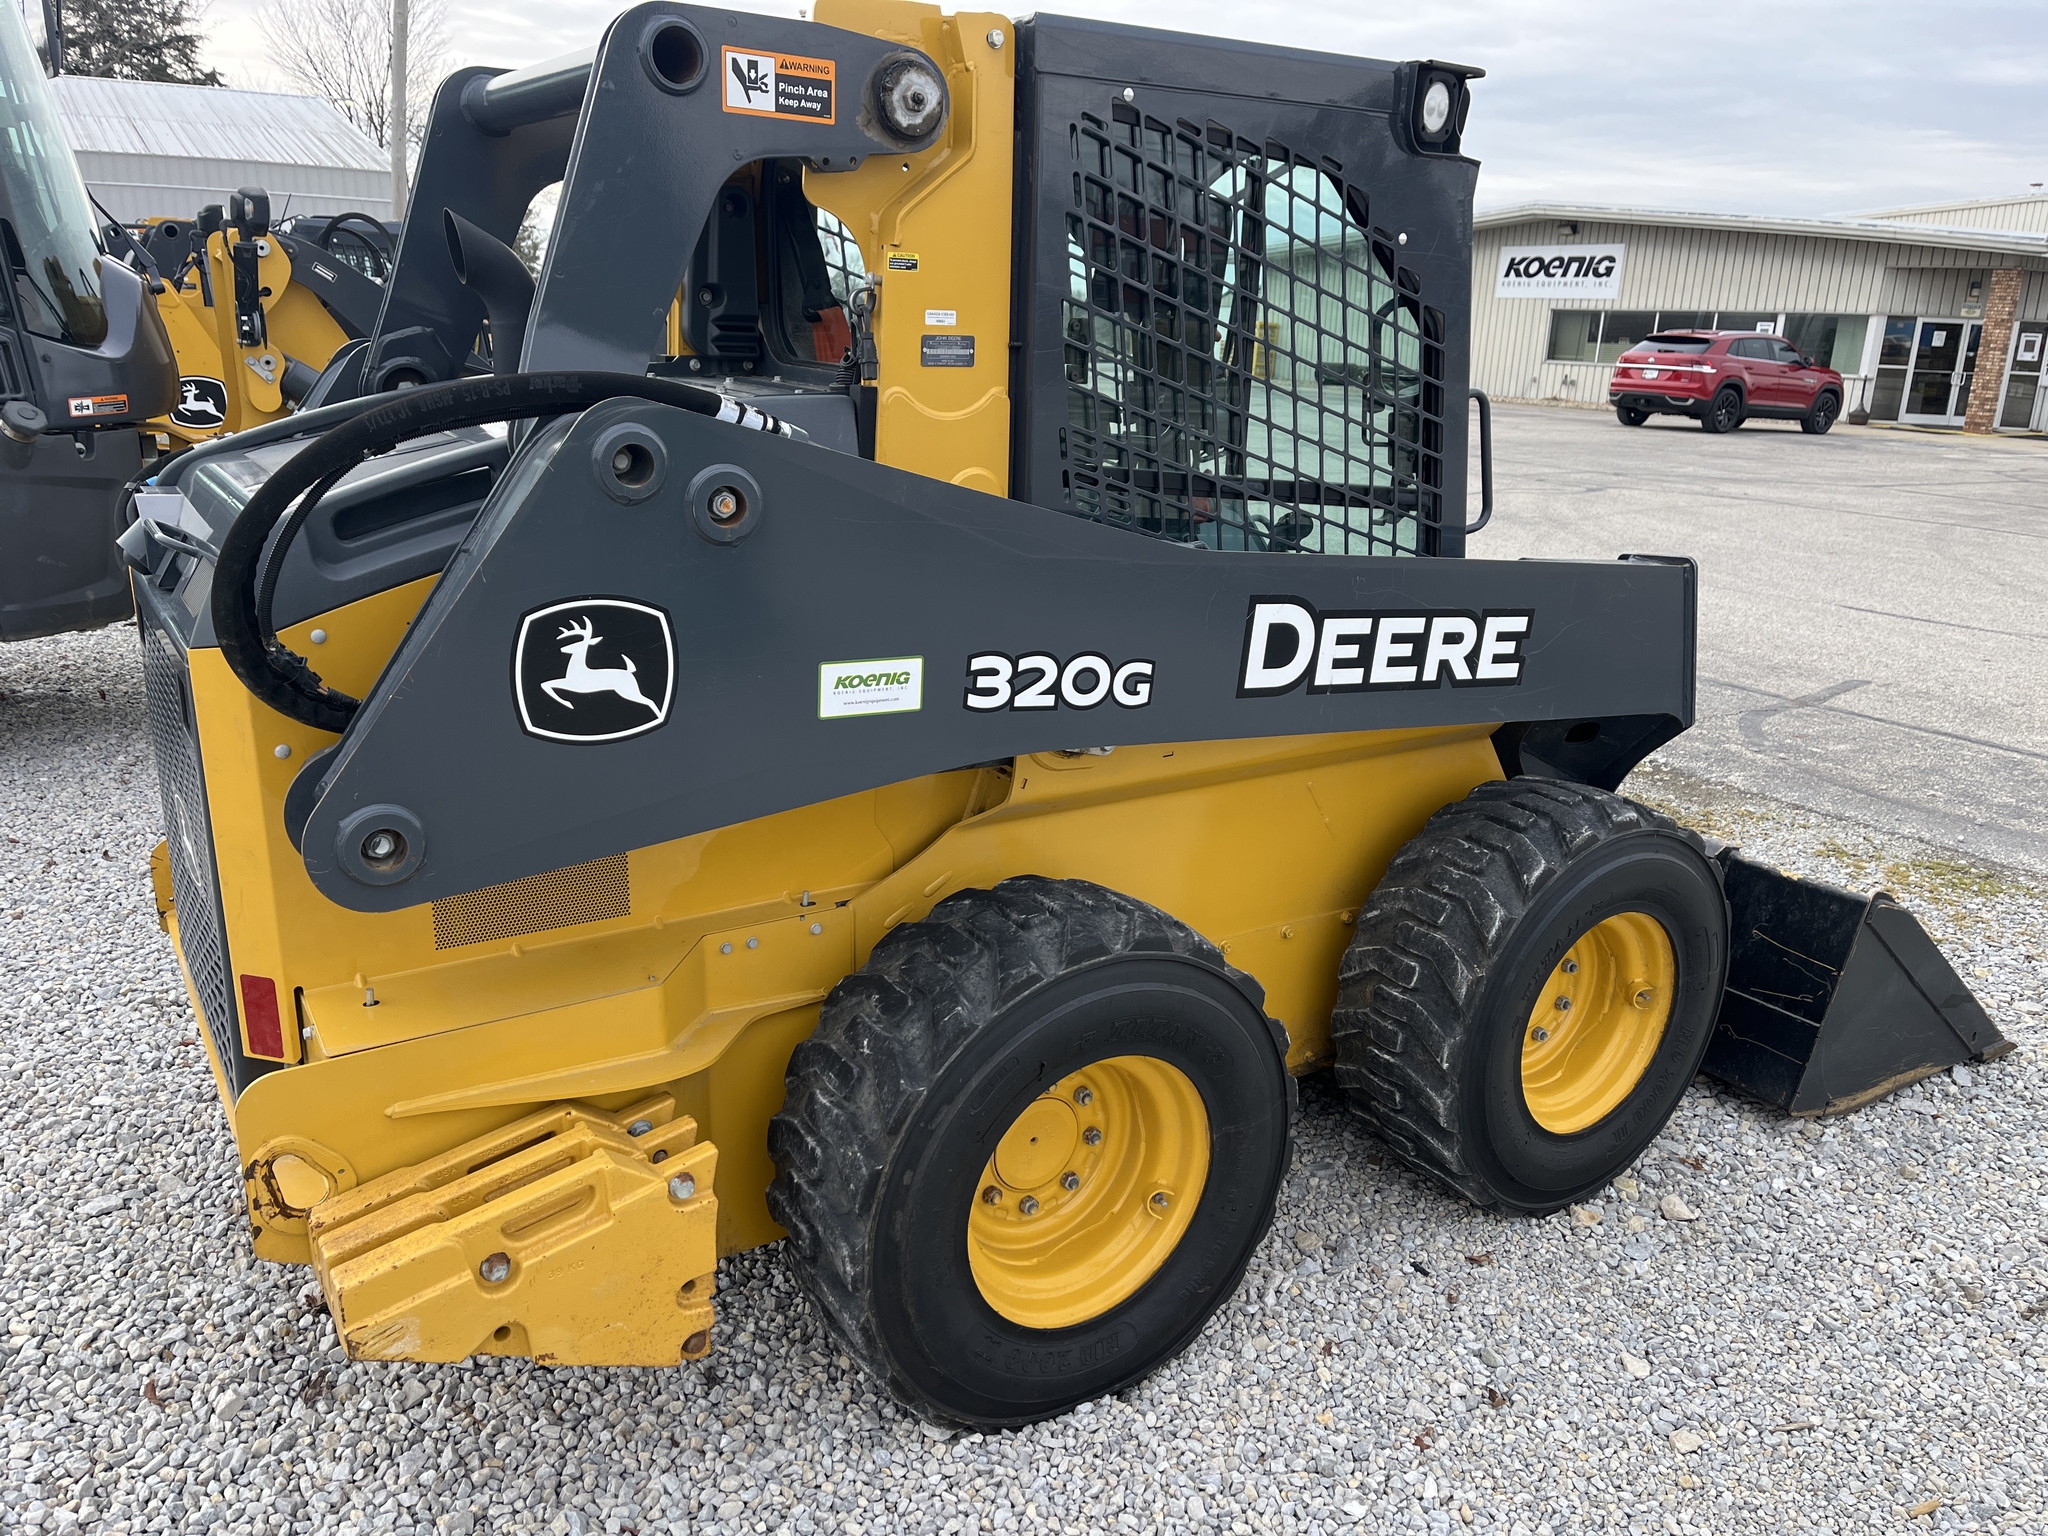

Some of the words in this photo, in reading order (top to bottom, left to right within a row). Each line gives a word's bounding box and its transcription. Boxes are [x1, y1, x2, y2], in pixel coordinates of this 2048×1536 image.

[788, 61, 830, 75] WARNING
[778, 82, 806, 95] Pinch
[806, 86, 829, 98] Area
[778, 96, 800, 109] Keep
[799, 98, 822, 112] Away
[1501, 279, 1532, 288] KOENIG
[1593, 279, 1613, 289] INC.
[528, 374, 583, 394] Parker
[1244, 602, 1530, 690] DEERE
[967, 654, 1154, 709] 320G
[1104, 1017, 1207, 1051] TITAN
[435, 1165, 459, 1181] USA
[451, 1192, 475, 1208] USA
[567, 1259, 586, 1273] KG
